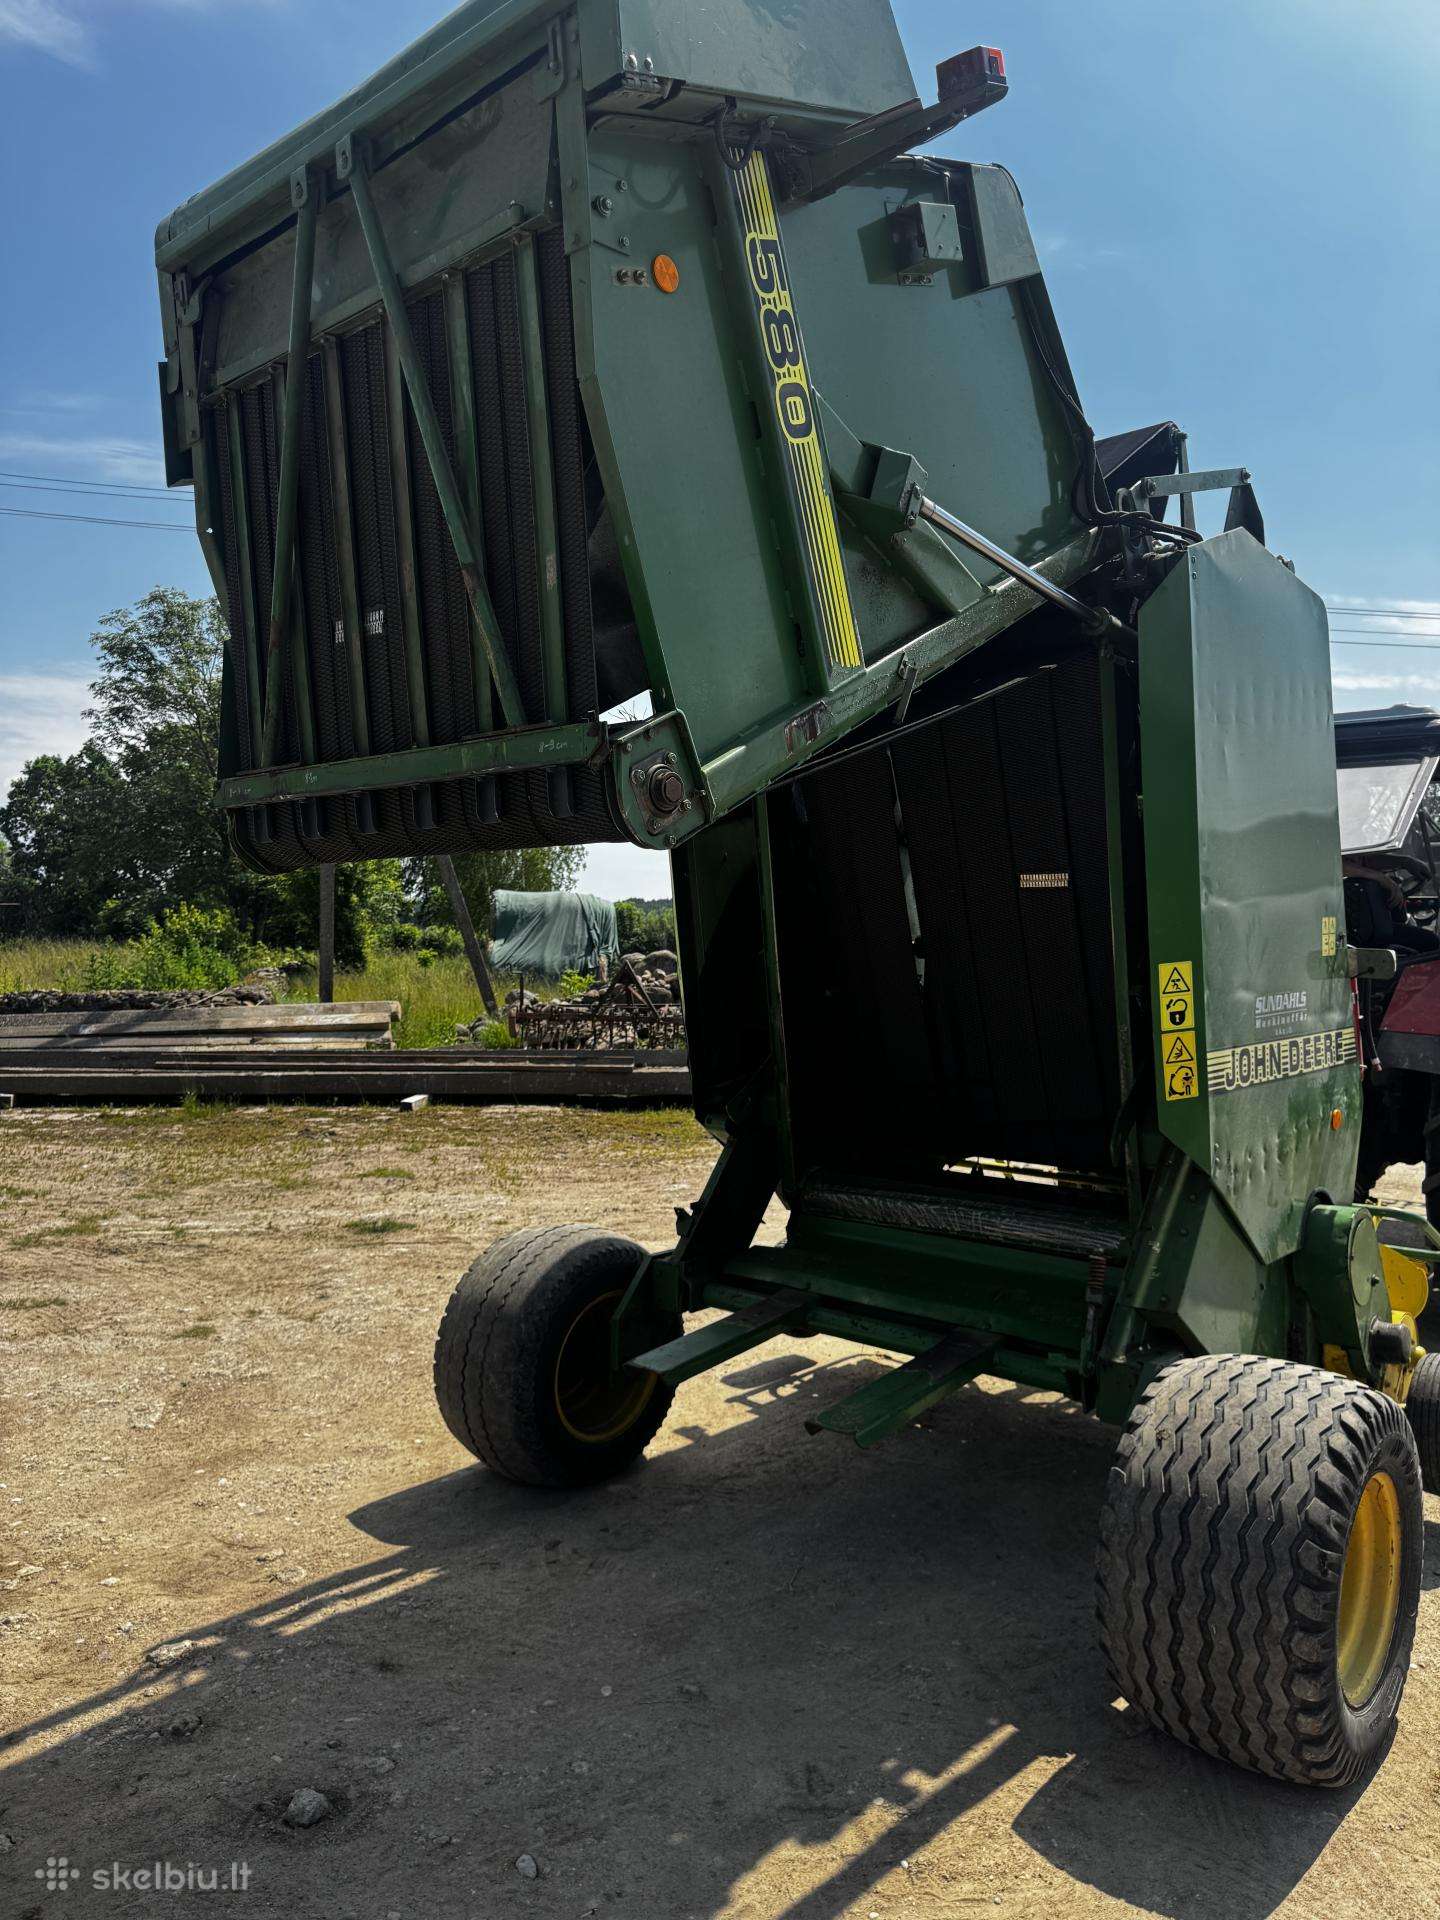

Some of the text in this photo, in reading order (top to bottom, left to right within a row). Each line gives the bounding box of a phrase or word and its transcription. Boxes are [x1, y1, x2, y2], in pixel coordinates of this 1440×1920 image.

[746, 234, 814, 441] 580
[1224, 1030, 1344, 1090] JOHN DEERE
